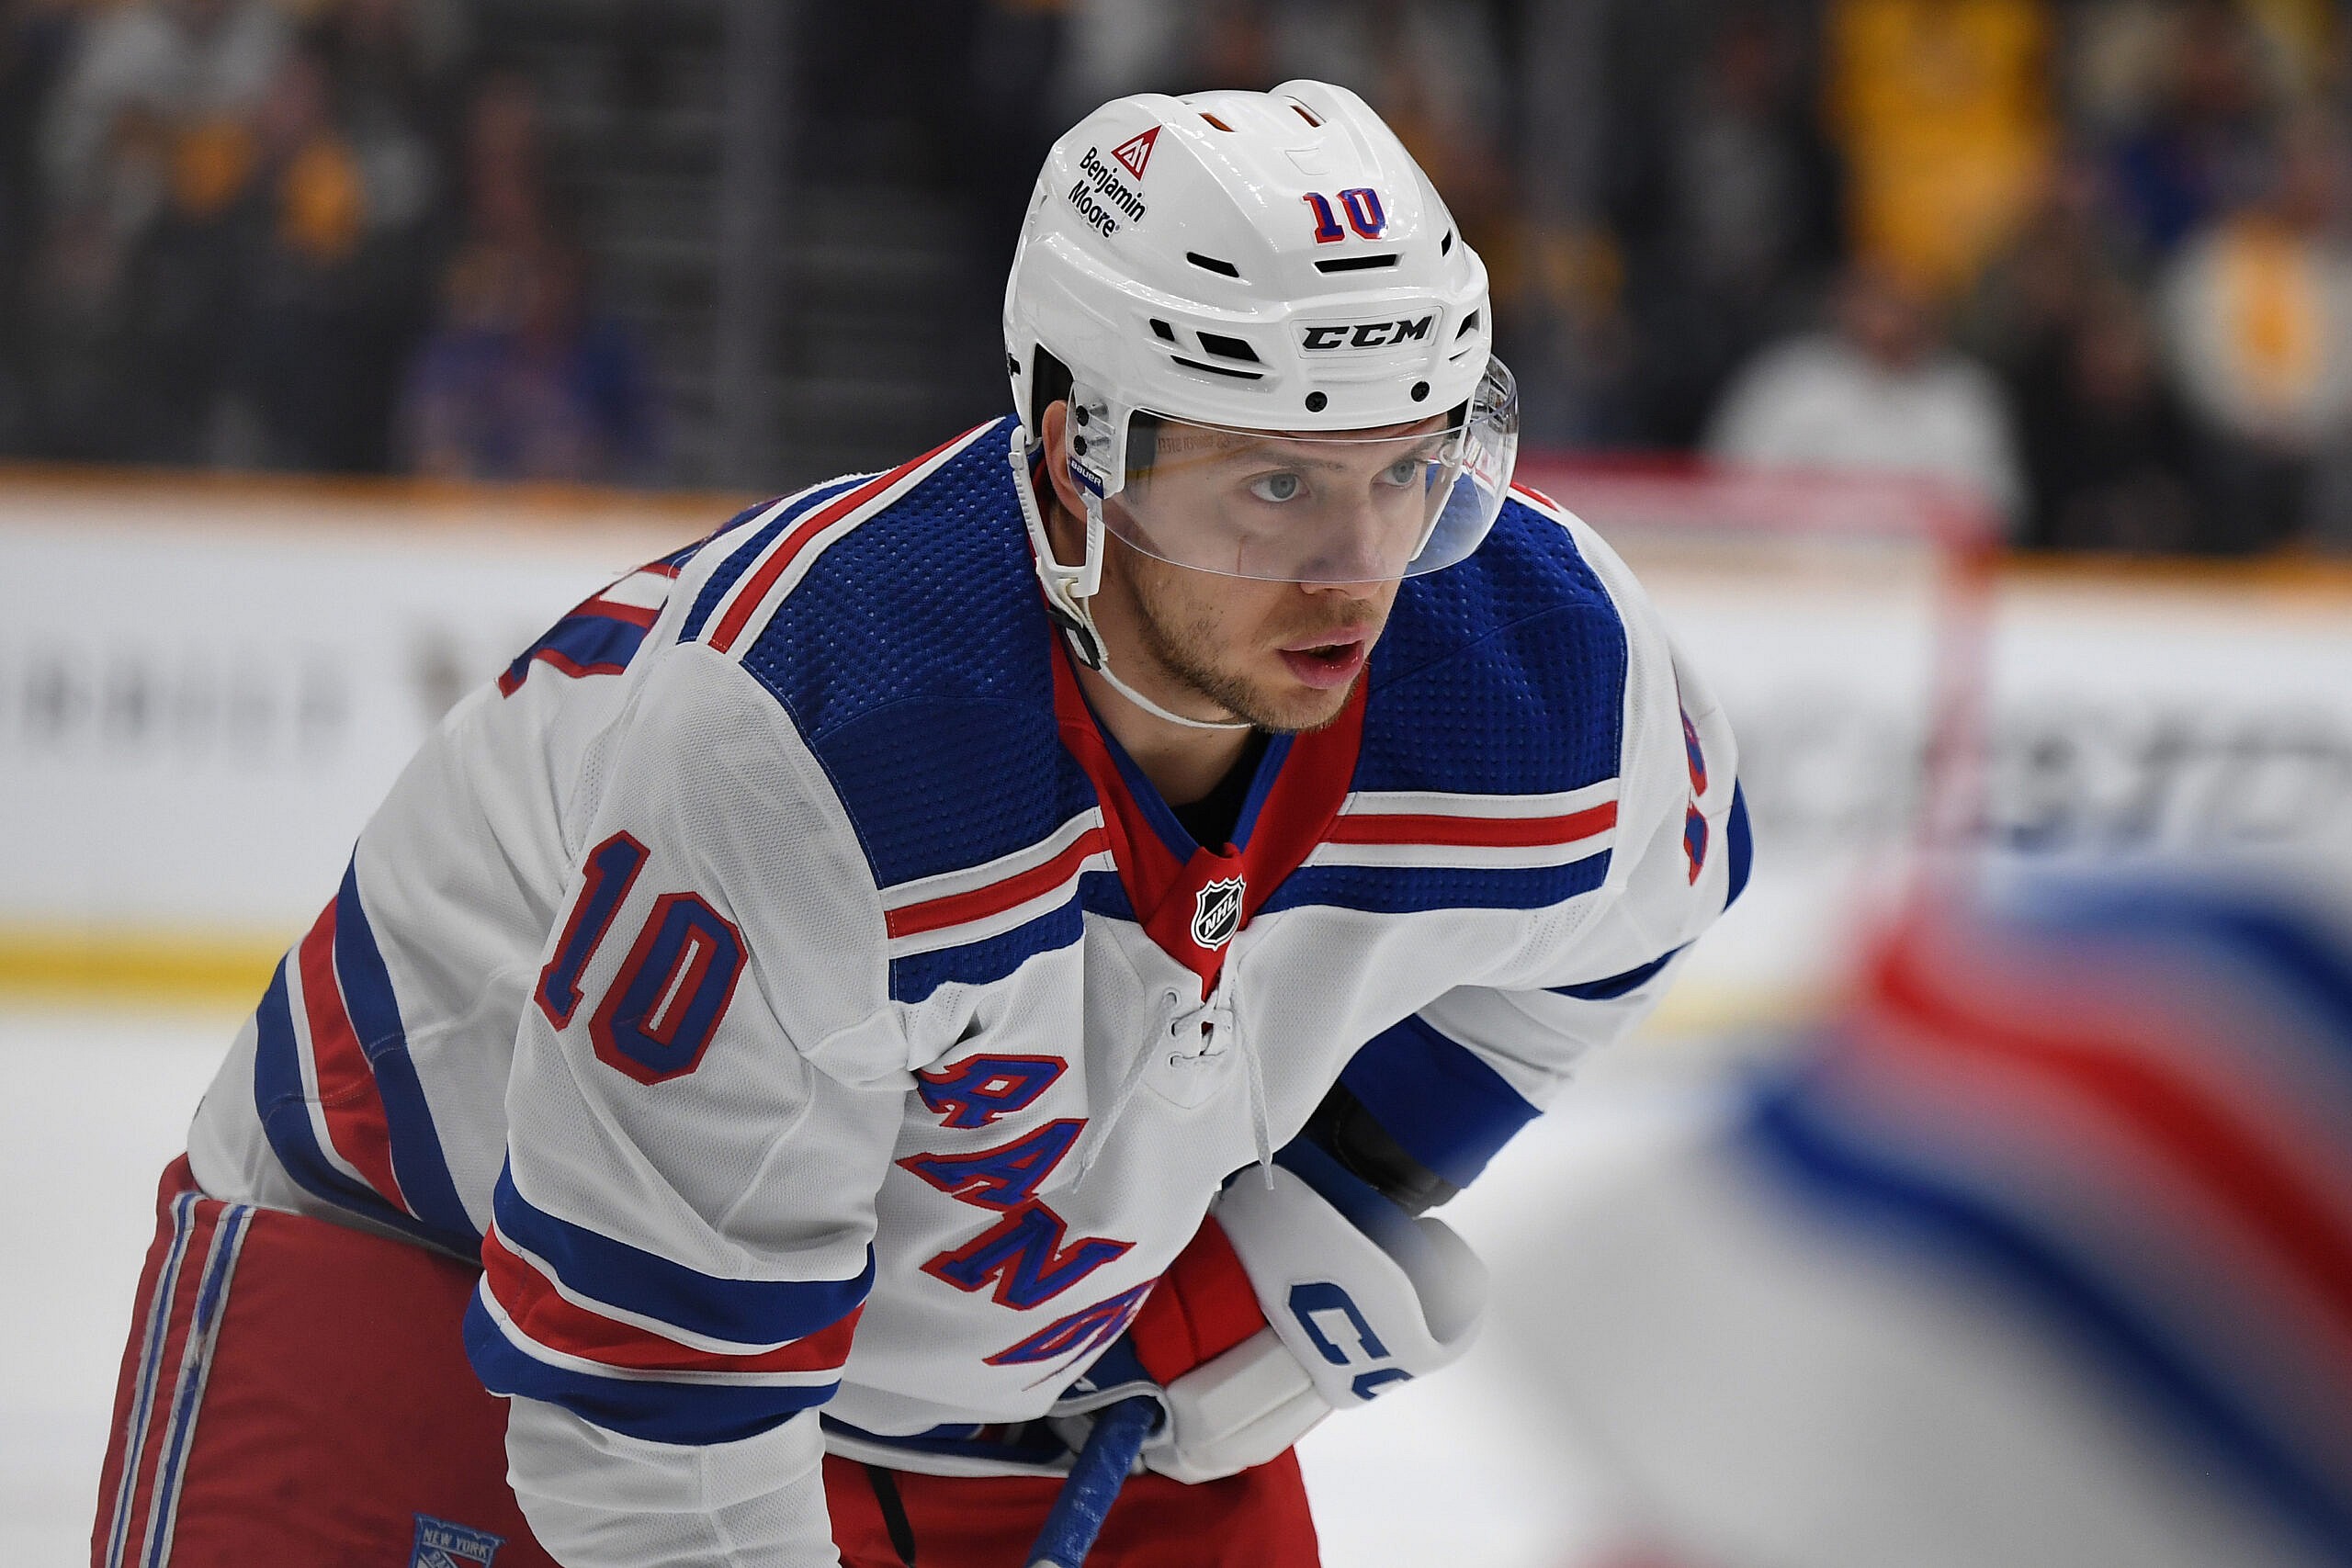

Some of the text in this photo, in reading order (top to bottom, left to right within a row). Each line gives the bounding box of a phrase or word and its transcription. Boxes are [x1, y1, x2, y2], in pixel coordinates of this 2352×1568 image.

[1080, 146, 1146, 222] Benjamin
[1302, 187, 1387, 243] 10
[1303, 316, 1432, 349] CCM
[1204, 895, 1236, 935] NHL
[533, 829, 749, 1087] 10
[424, 1527, 452, 1546] NEW
[456, 1536, 489, 1560] YORK
